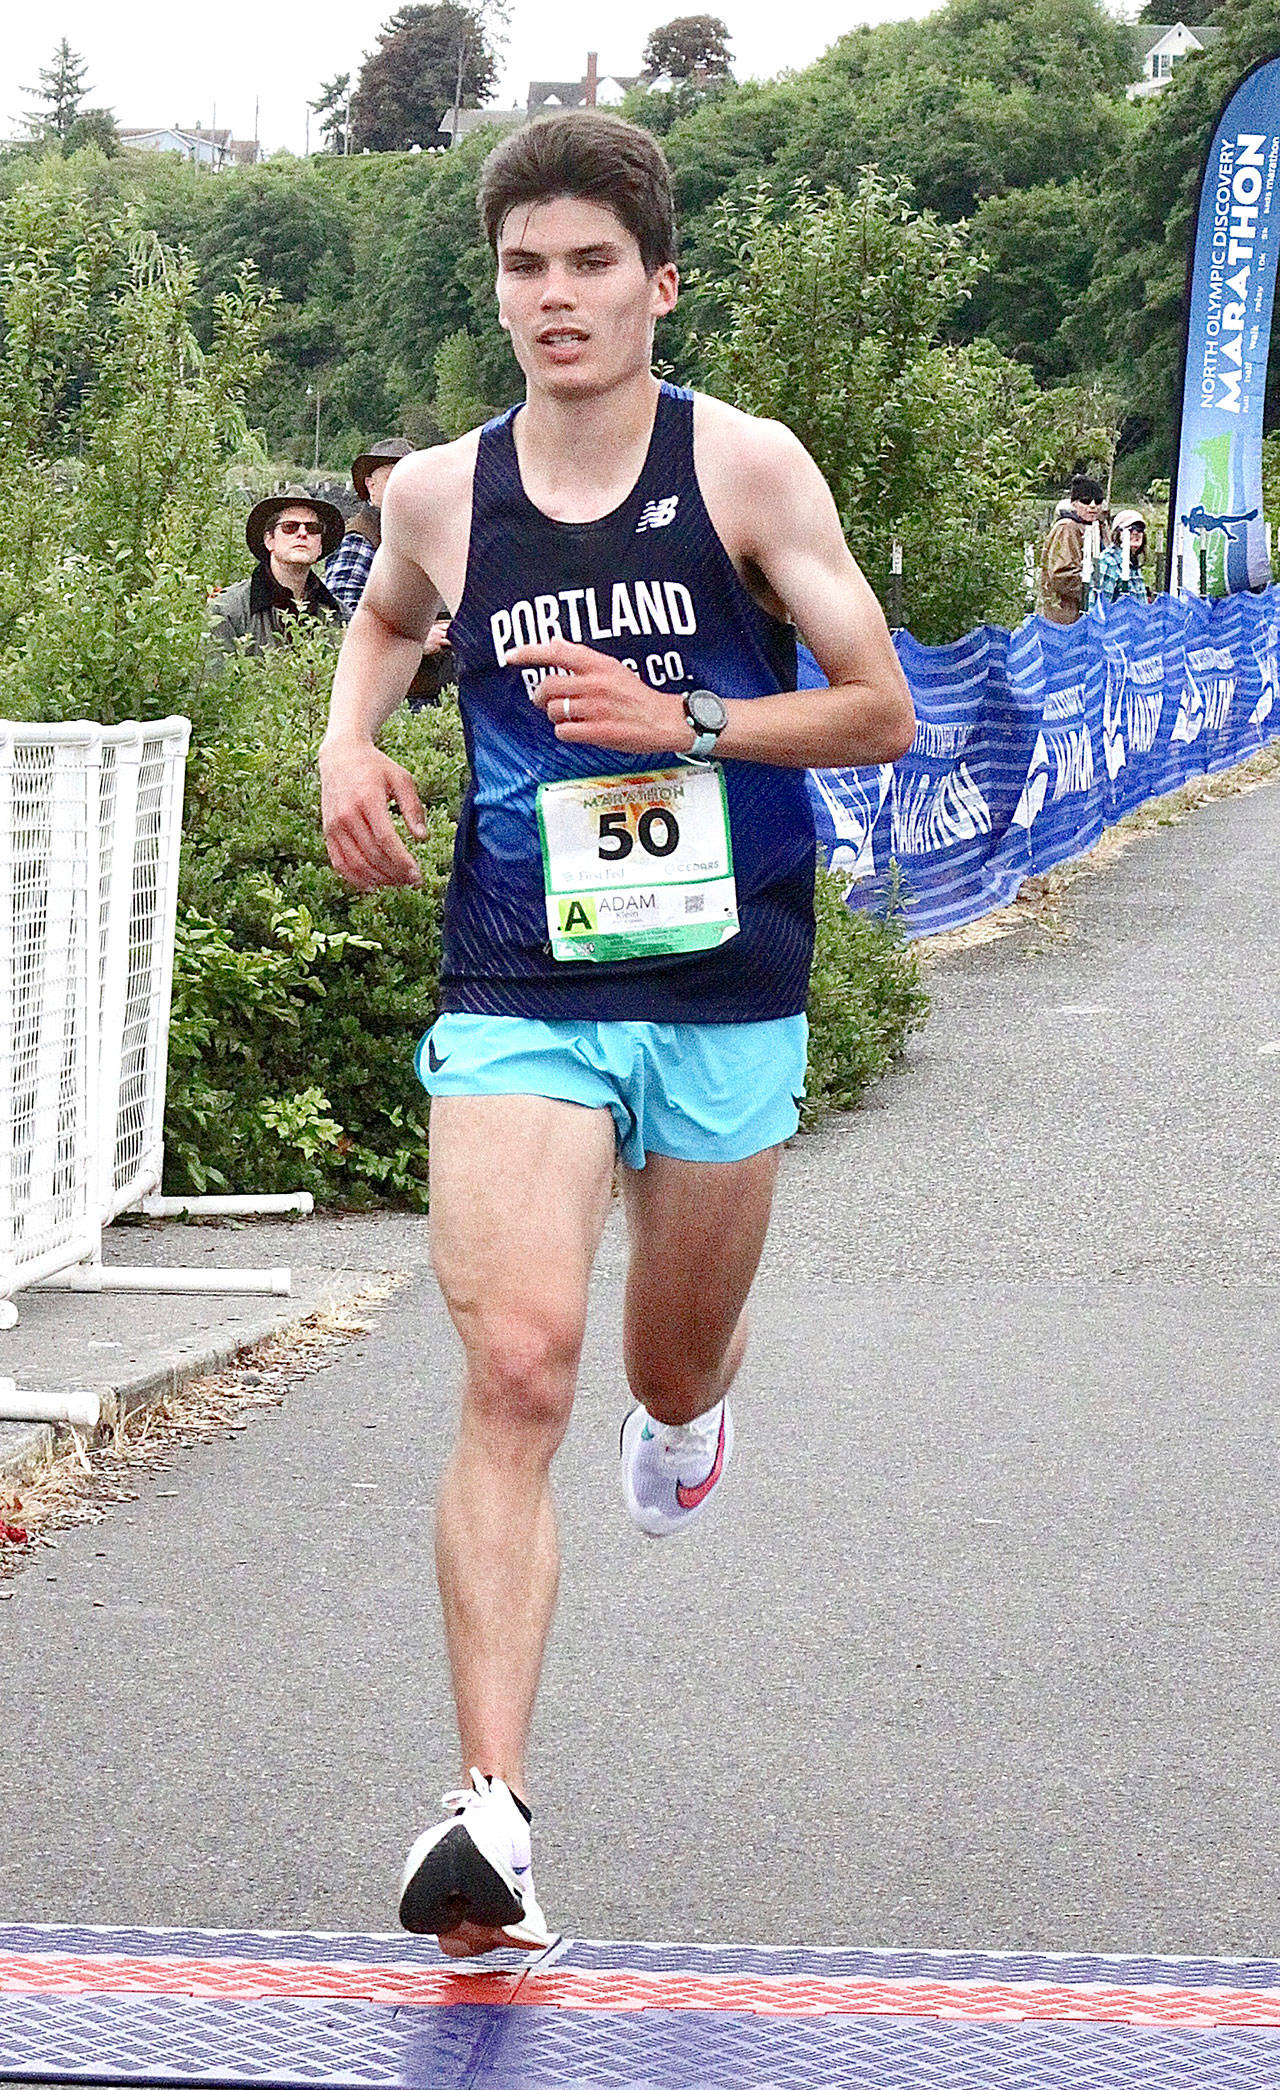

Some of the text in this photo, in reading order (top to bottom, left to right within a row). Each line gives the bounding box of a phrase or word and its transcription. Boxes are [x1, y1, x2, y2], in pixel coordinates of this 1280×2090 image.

[1248, 325, 1260, 350] walk
[1256, 253, 1267, 271] 10k
[1265, 136, 1280, 190] marathon
[1200, 139, 1235, 408] NORTH OLYMPIC DISCOVERY
[1214, 134, 1268, 414] MARATHON
[490, 580, 697, 668] PORTLAND
[645, 651, 694, 686] CO.
[583, 786, 685, 808] MARATHON
[598, 807, 680, 861] 50
[677, 861, 719, 874] CEDARS
[564, 901, 593, 932] A
[599, 893, 656, 912] ADAM
